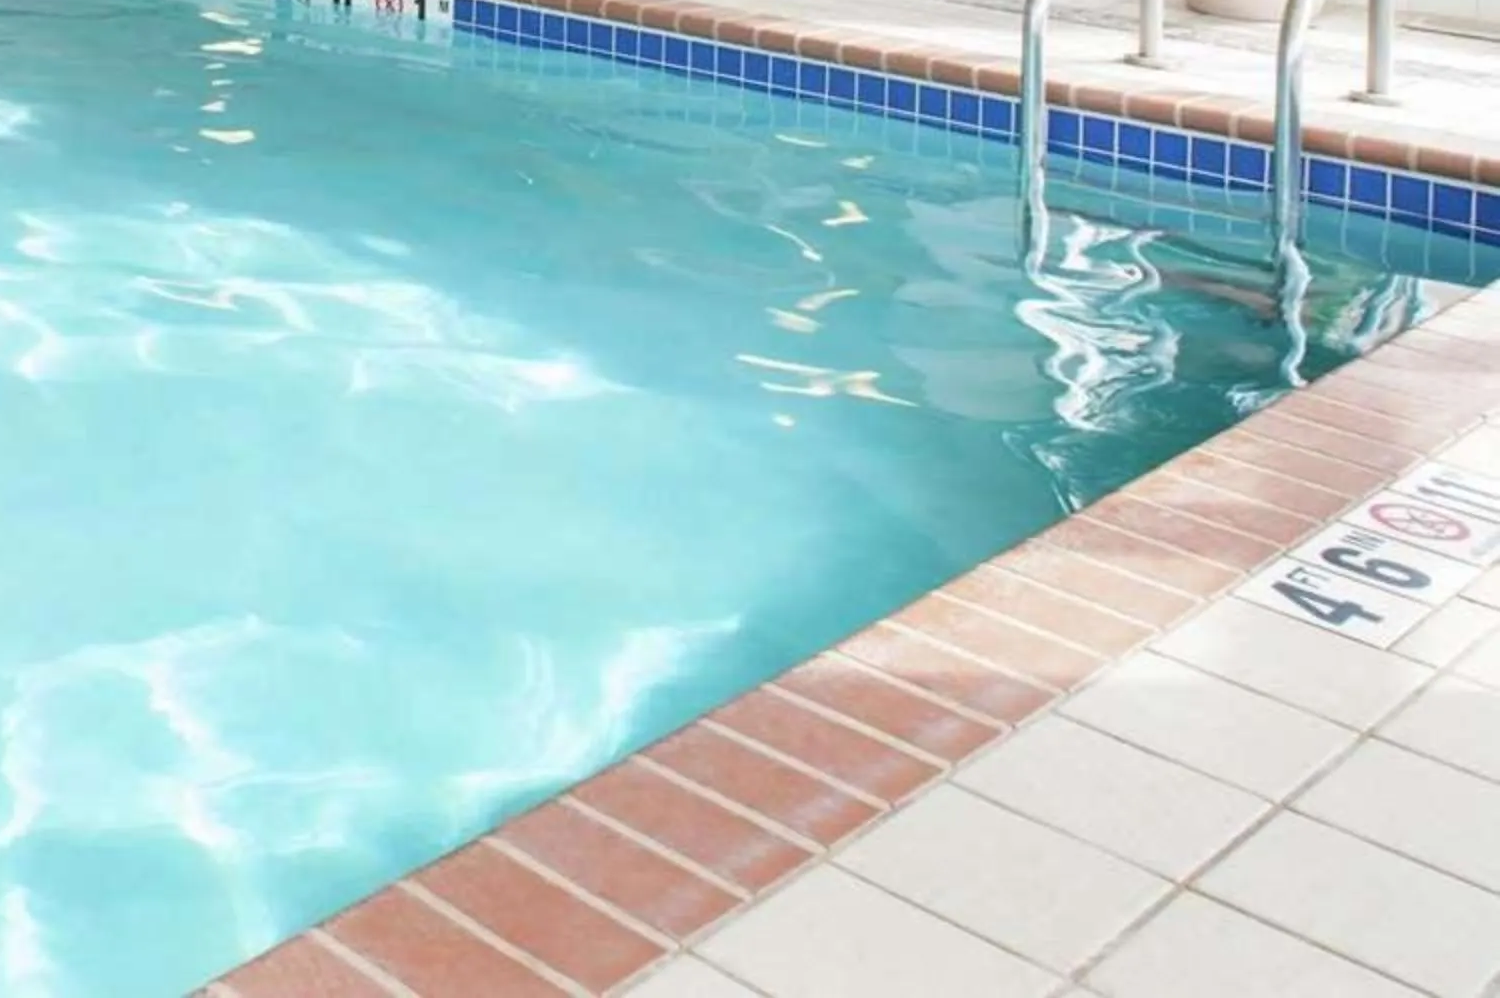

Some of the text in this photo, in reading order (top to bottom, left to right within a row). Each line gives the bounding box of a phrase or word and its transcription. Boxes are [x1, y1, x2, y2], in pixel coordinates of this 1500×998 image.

[1285, 566, 1331, 590] FT
[1320, 546, 1432, 589] 6
[1271, 580, 1384, 627] 4
